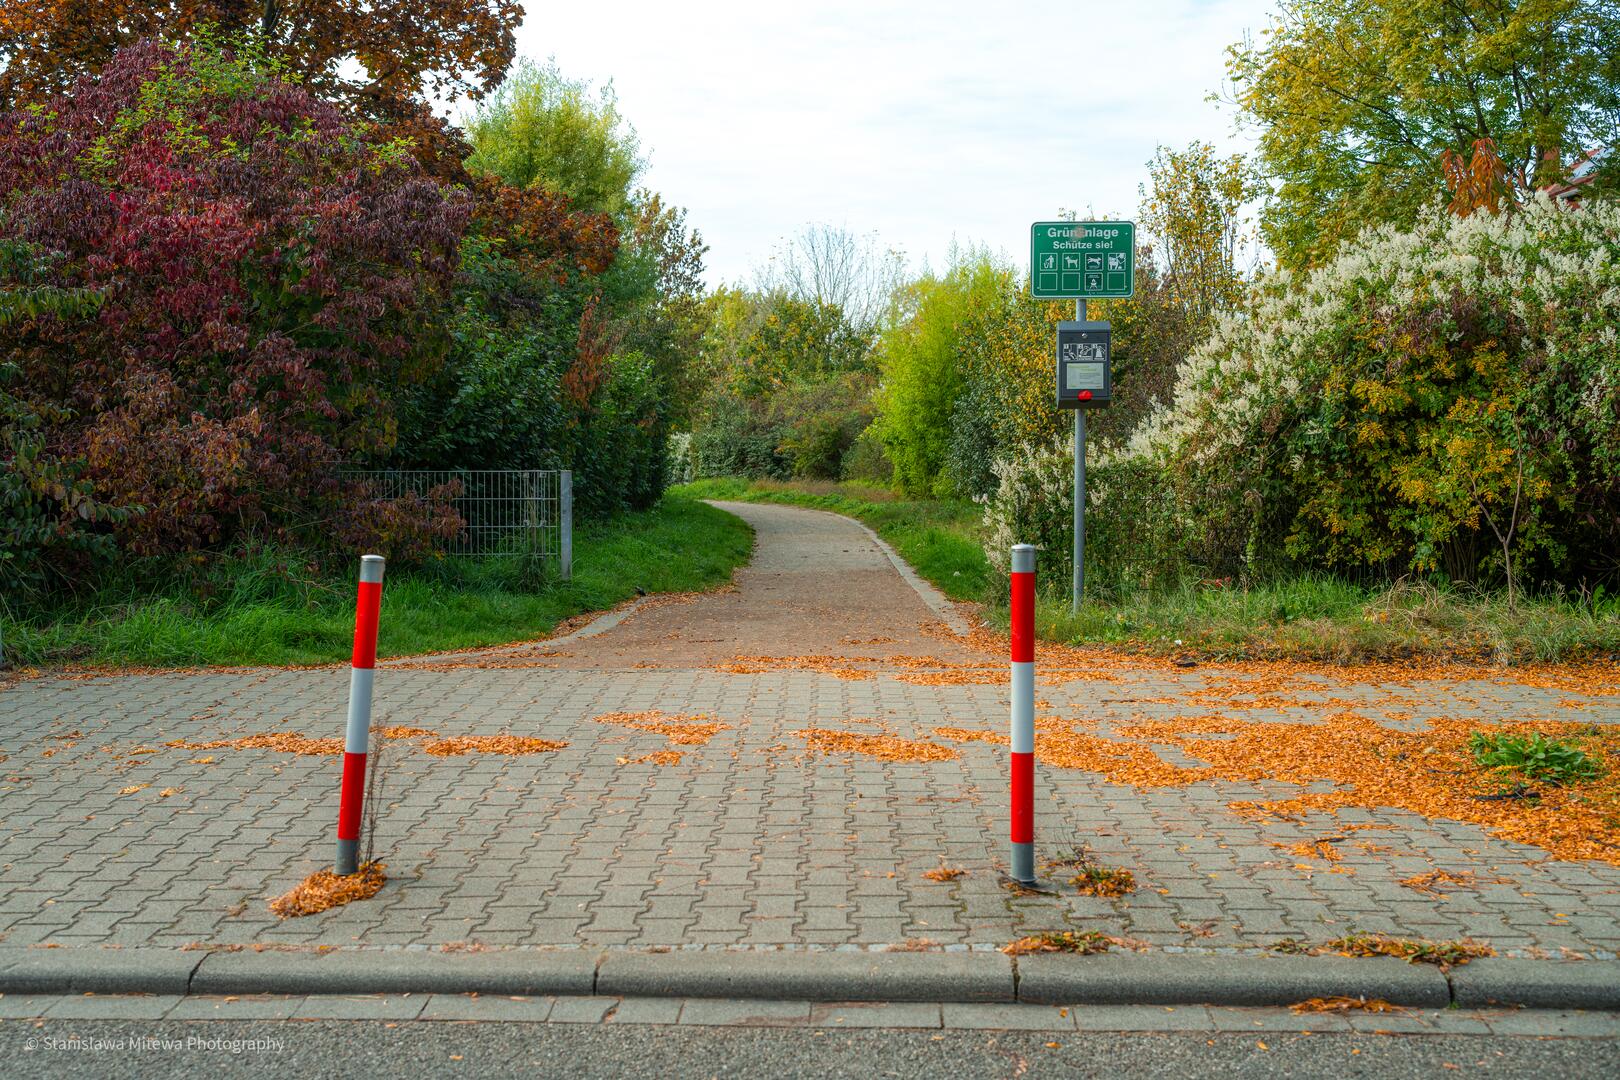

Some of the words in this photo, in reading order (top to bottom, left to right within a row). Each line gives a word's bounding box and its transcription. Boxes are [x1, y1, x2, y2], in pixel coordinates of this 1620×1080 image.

[1047, 227, 1119, 239] Grünnlage
[1053, 240, 1093, 249] Schütze
[1095, 240, 1113, 249] sie!
